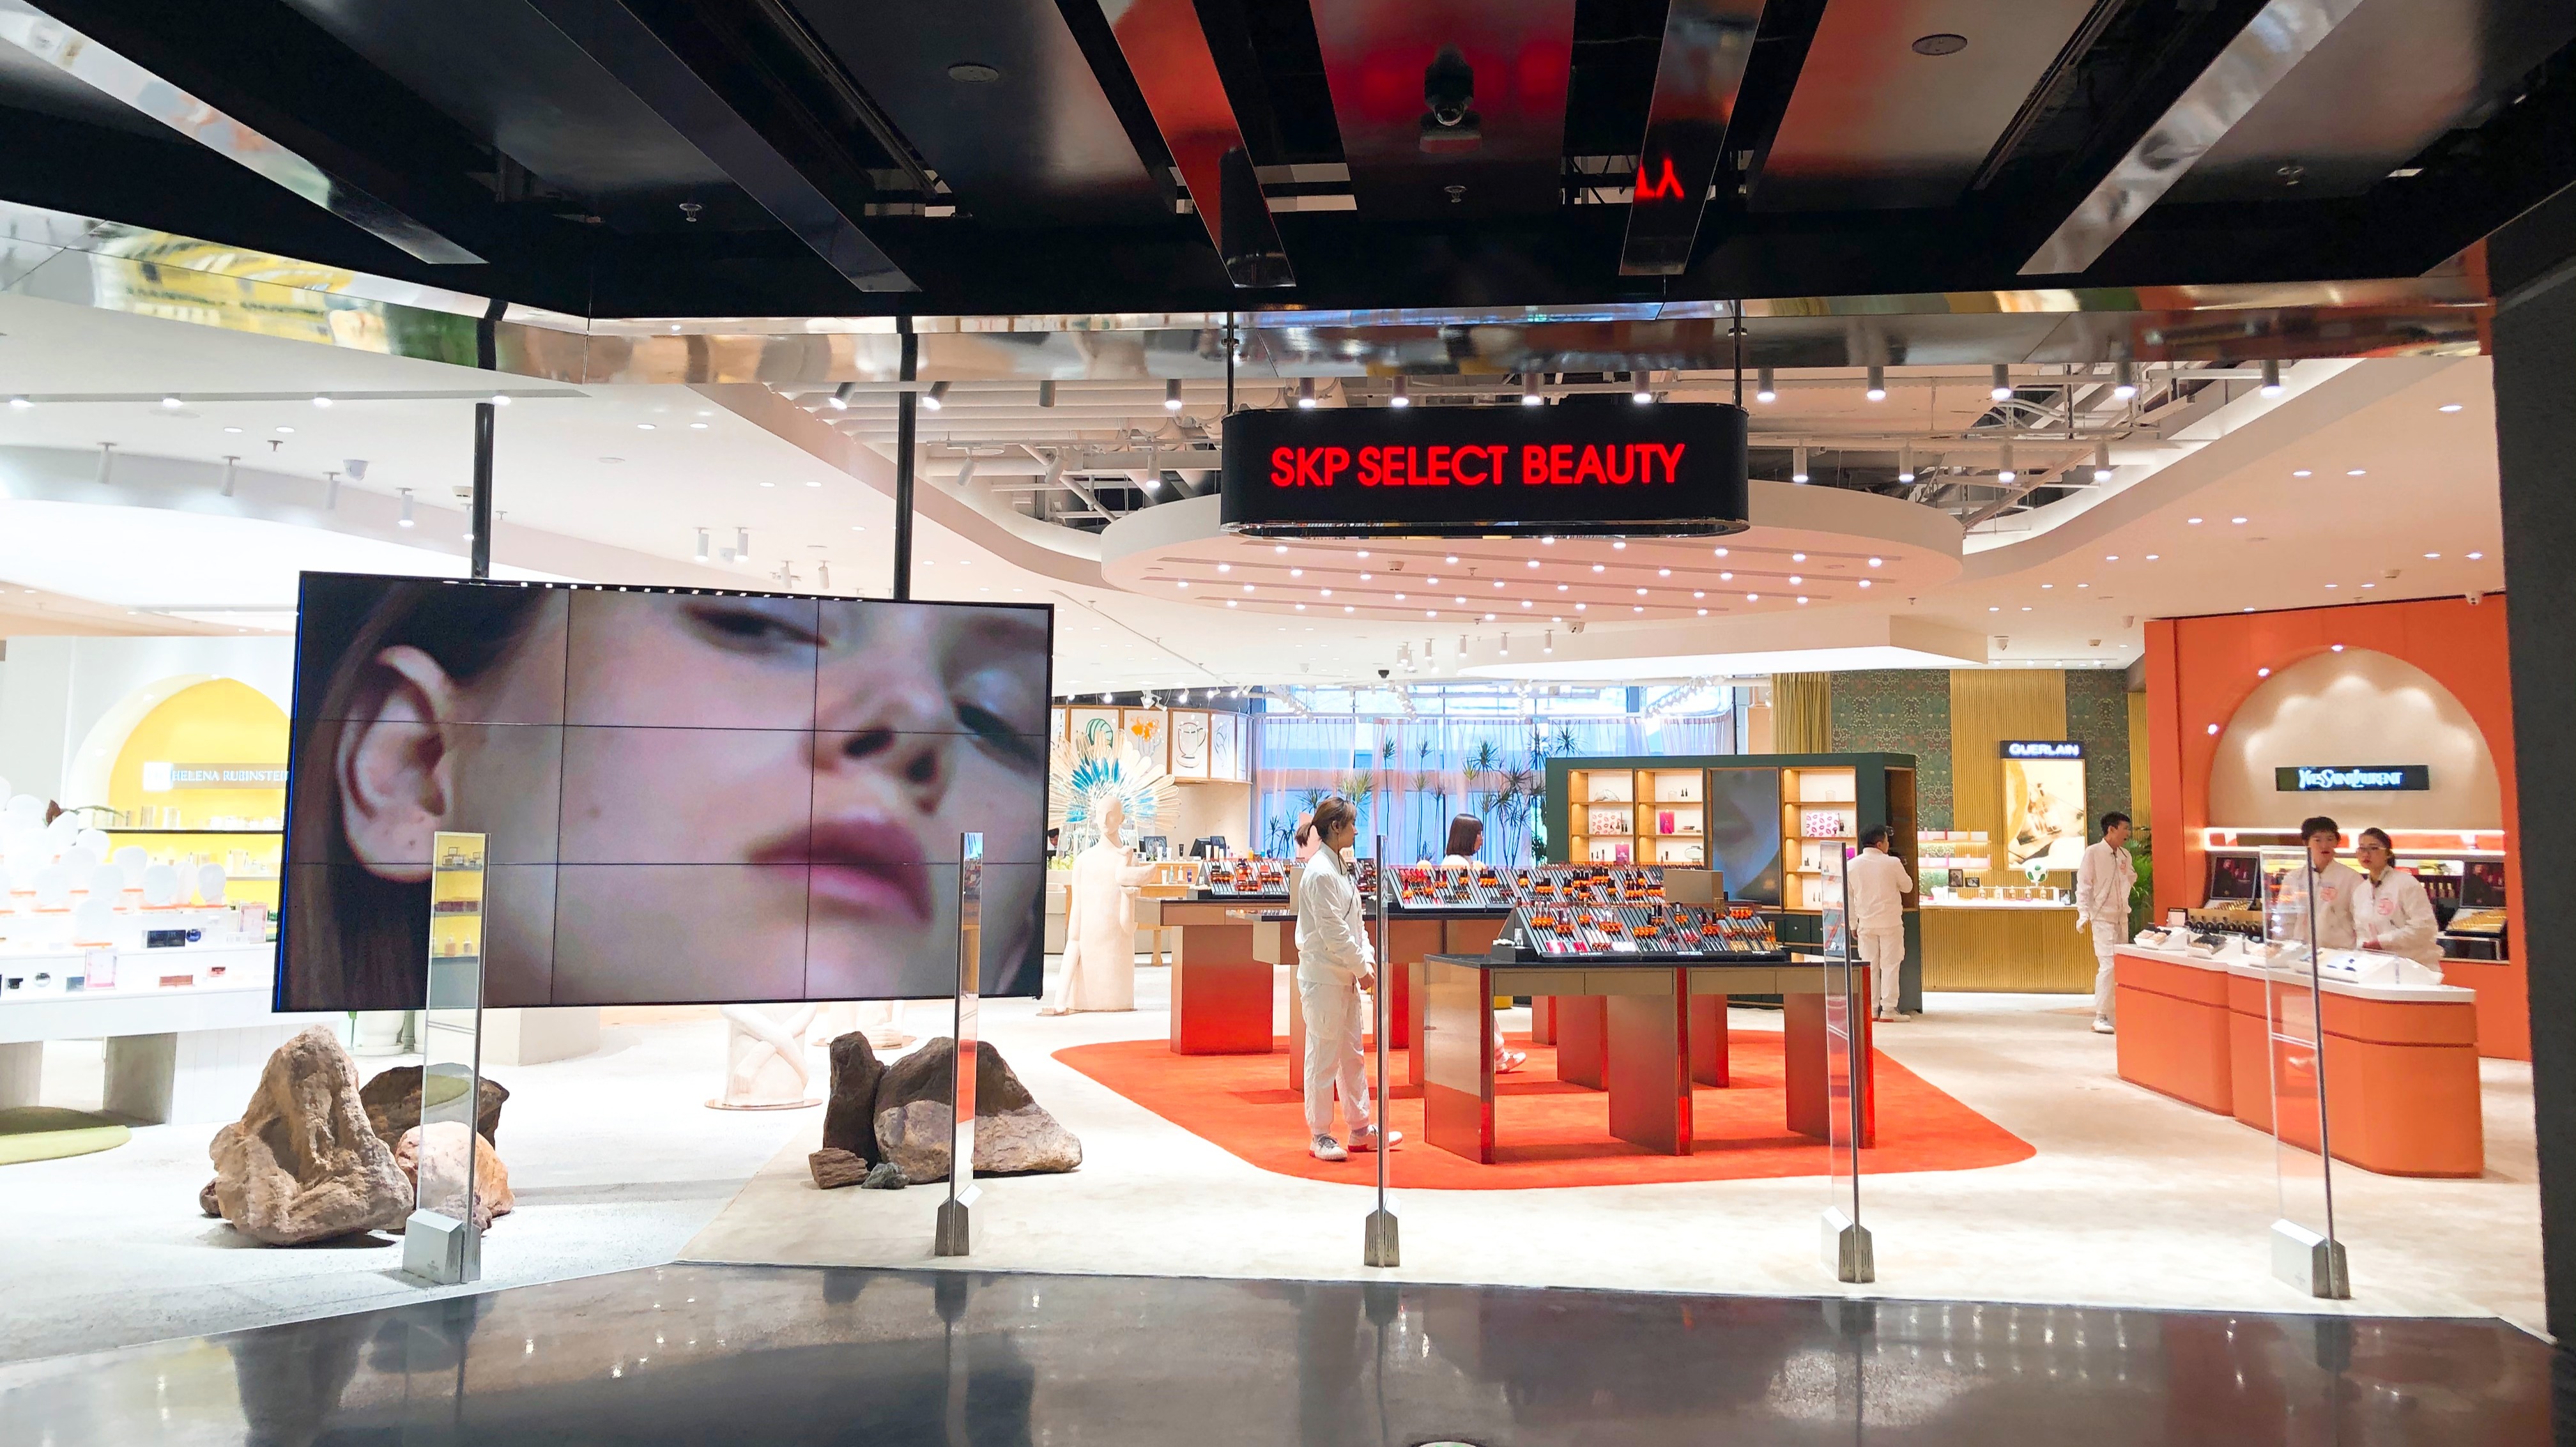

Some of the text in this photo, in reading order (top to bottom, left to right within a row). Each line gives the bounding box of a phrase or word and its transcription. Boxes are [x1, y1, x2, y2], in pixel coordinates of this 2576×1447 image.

[1271, 443, 1685, 487] SKP SELECT BEAUTY
[2009, 743, 2080, 756] GUERLAIN
[172, 770, 220, 781] HELENA
